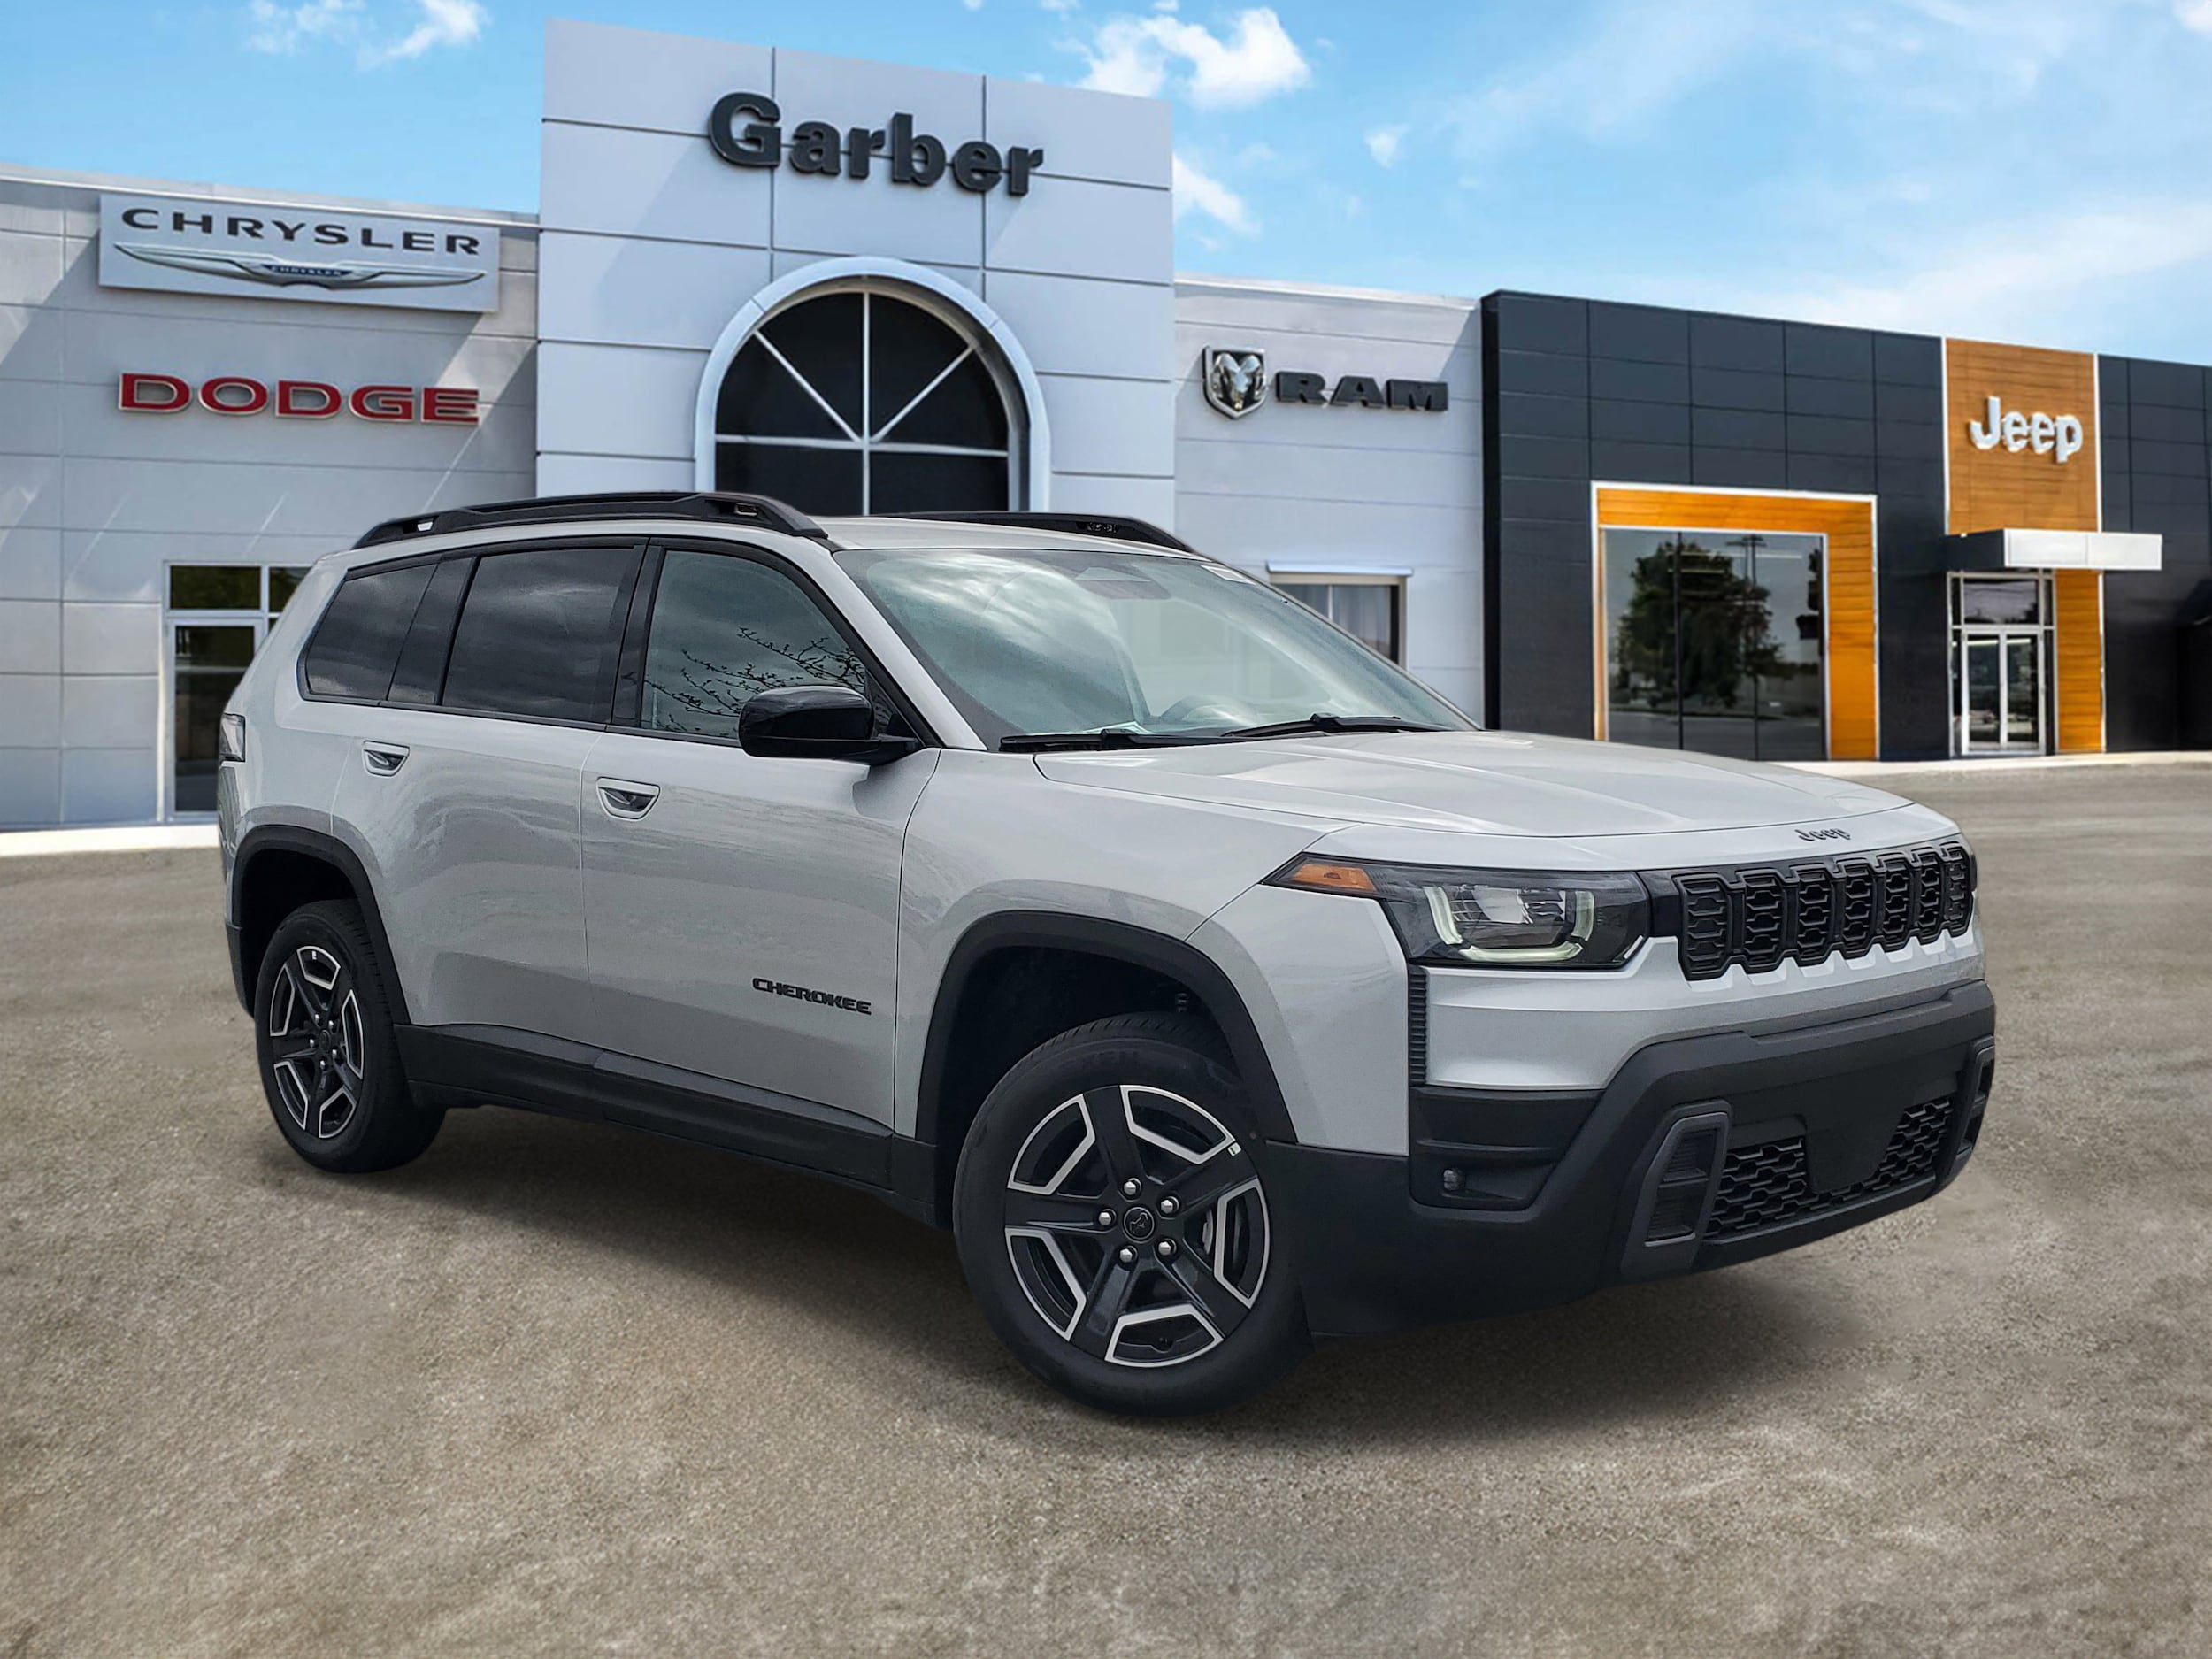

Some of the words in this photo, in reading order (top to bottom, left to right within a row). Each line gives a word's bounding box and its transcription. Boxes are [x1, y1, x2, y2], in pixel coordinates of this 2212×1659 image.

[708, 91, 1044, 196] Garber
[122, 208, 480, 254] CHRYSLER
[119, 373, 480, 424] DODGE
[1274, 370, 1448, 411] RAM
[1969, 396, 2084, 464] Jeep
[1794, 828, 1851, 841] Jeep
[752, 978, 872, 1015] CHEROKEE
